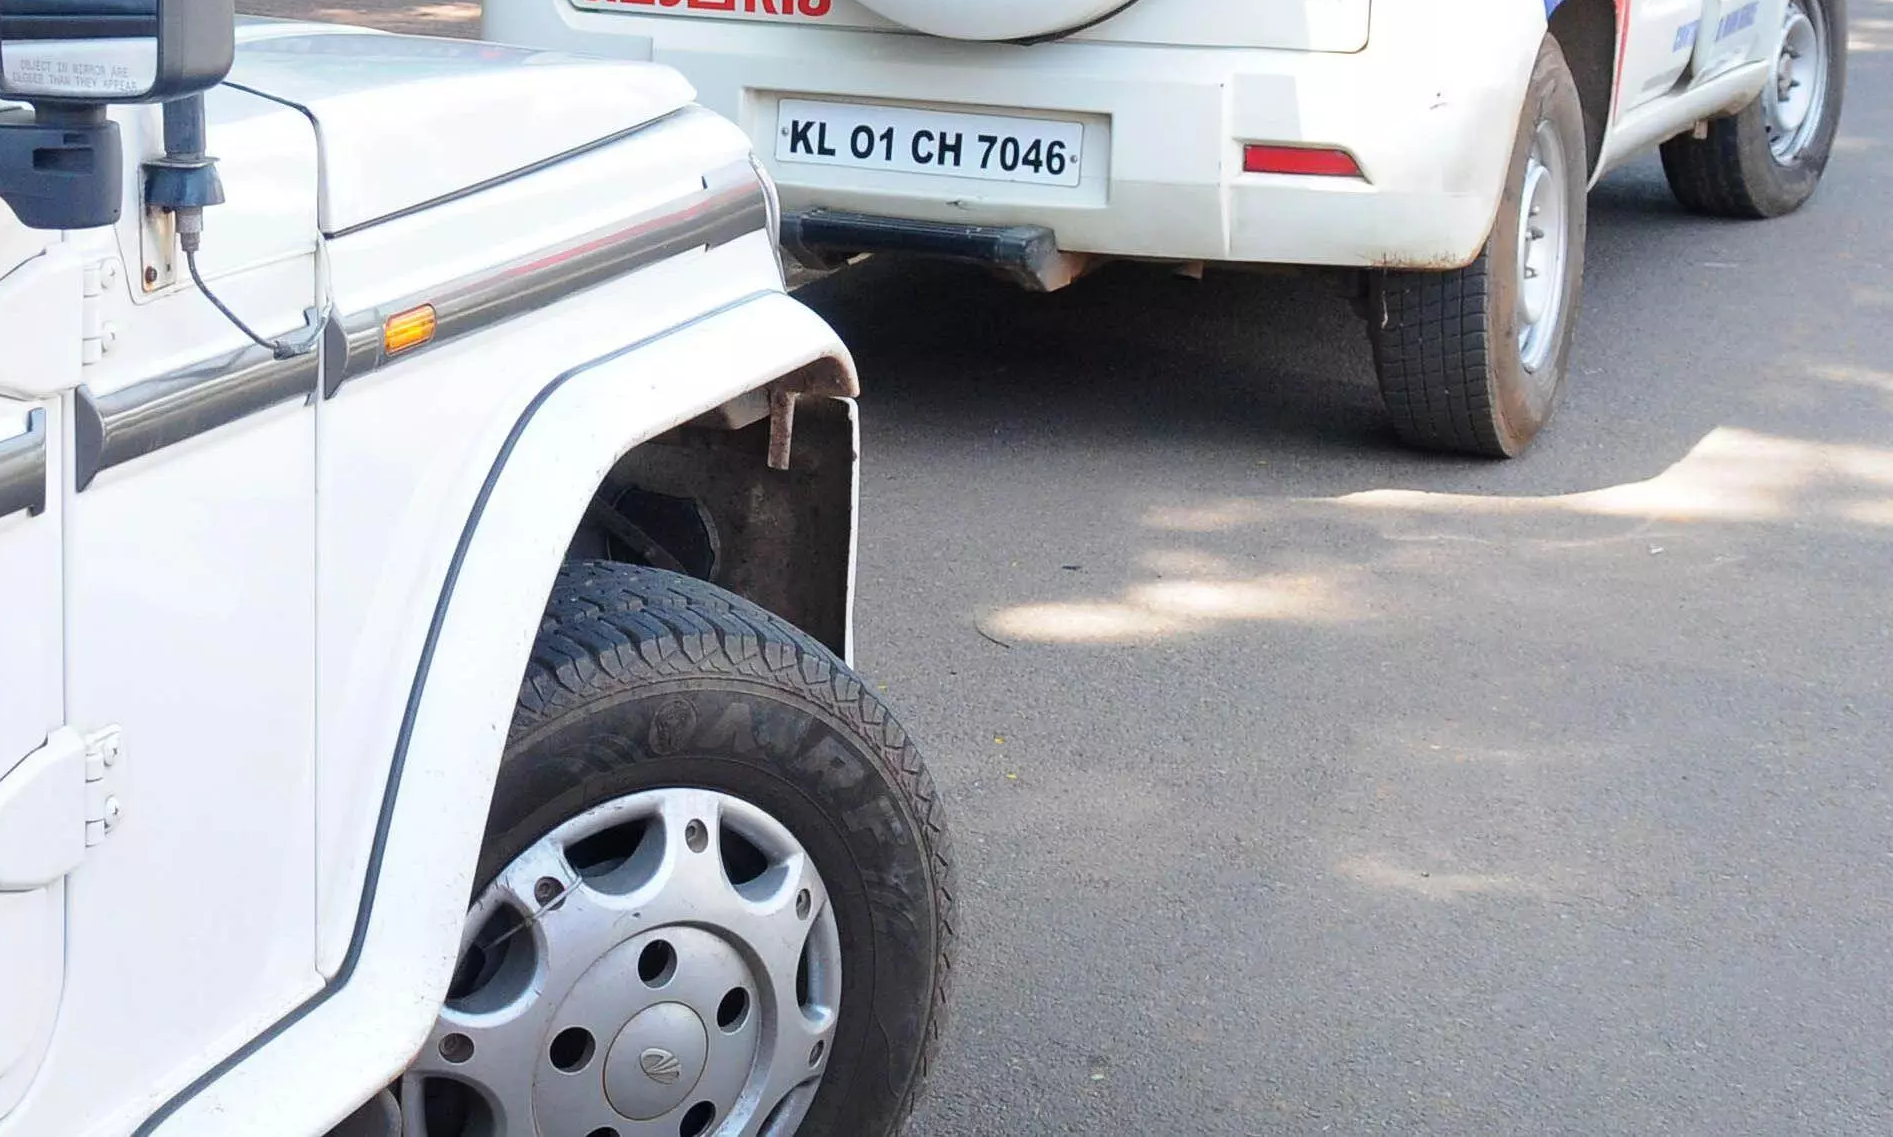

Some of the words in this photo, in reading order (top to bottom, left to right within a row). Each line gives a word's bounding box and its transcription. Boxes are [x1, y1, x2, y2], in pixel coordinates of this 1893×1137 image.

[73, 63, 106, 76] MIRROR
[112, 65, 129, 78] ARE
[50, 74, 71, 85] THAN
[76, 76, 96, 89] THEY
[103, 79, 137, 91] APPEAR
[790, 120, 836, 156] KL
[850, 124, 894, 161] 01
[911, 130, 963, 167] CH
[977, 134, 1067, 175] 7046
